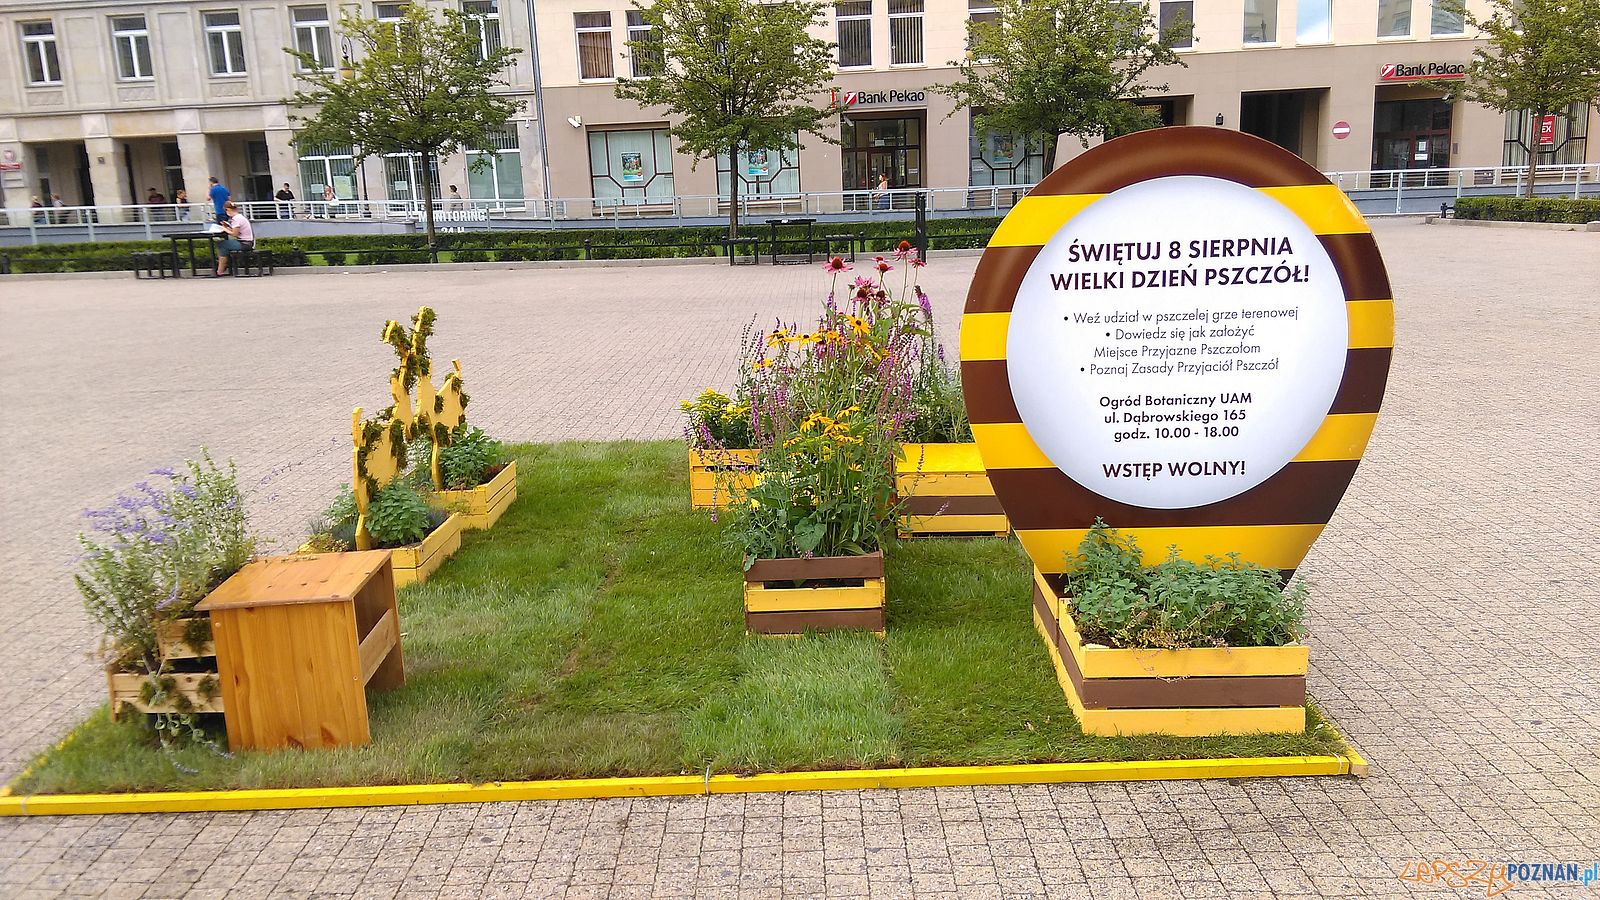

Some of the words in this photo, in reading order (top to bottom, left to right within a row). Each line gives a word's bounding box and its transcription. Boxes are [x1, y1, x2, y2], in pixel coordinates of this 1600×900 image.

[1396, 63, 1426, 77] Bank
[858, 91, 887, 104] Bank
[889, 89, 925, 103] Pekao
[418, 210, 486, 222] MNITORING
[1068, 238, 1161, 266] ŚWIĘTUJ
[1168, 241, 1182, 260] 8
[1188, 236, 1294, 259] SIERPNIA
[1050, 271, 1124, 291] WIELKI
[1131, 263, 1198, 289] DZIEŃ
[1204, 259, 1310, 286] PSZCZÓŁ!
[1073, 312, 1101, 324] Weź
[1104, 310, 1139, 323] udział
[1142, 314, 1153, 322] w
[1156, 308, 1209, 325] pszczelej
[1212, 311, 1238, 323] grze
[1241, 306, 1299, 321] terenowej
[1115, 327, 1167, 340] Dowiedz
[1170, 327, 1186, 341] się
[1189, 325, 1206, 341] jak
[1209, 324, 1255, 340] założyć
[1093, 346, 1138, 361] Miejsce
[1141, 345, 1197, 360] Przyjazne
[1201, 341, 1261, 355] Pszczołom
[1090, 363, 1128, 377] Poznaj
[1131, 361, 1174, 376] Zasady
[1177, 359, 1233, 376] Przyjaciół
[1236, 357, 1279, 371] Pszczół
[1099, 394, 1142, 410] Ogród
[1145, 393, 1217, 407] Botaniczny
[1220, 392, 1252, 404] UAM
[1104, 411, 1120, 424] ul.
[1123, 410, 1219, 426] Dąbrowskiego
[1223, 409, 1246, 421] 165
[1113, 428, 1150, 442] godz.
[1154, 427, 1191, 439] 10.00
[1203, 426, 1239, 438] 18.00
[1102, 462, 1163, 481] WSTĘP
[1167, 460, 1246, 477] WOLNY!
